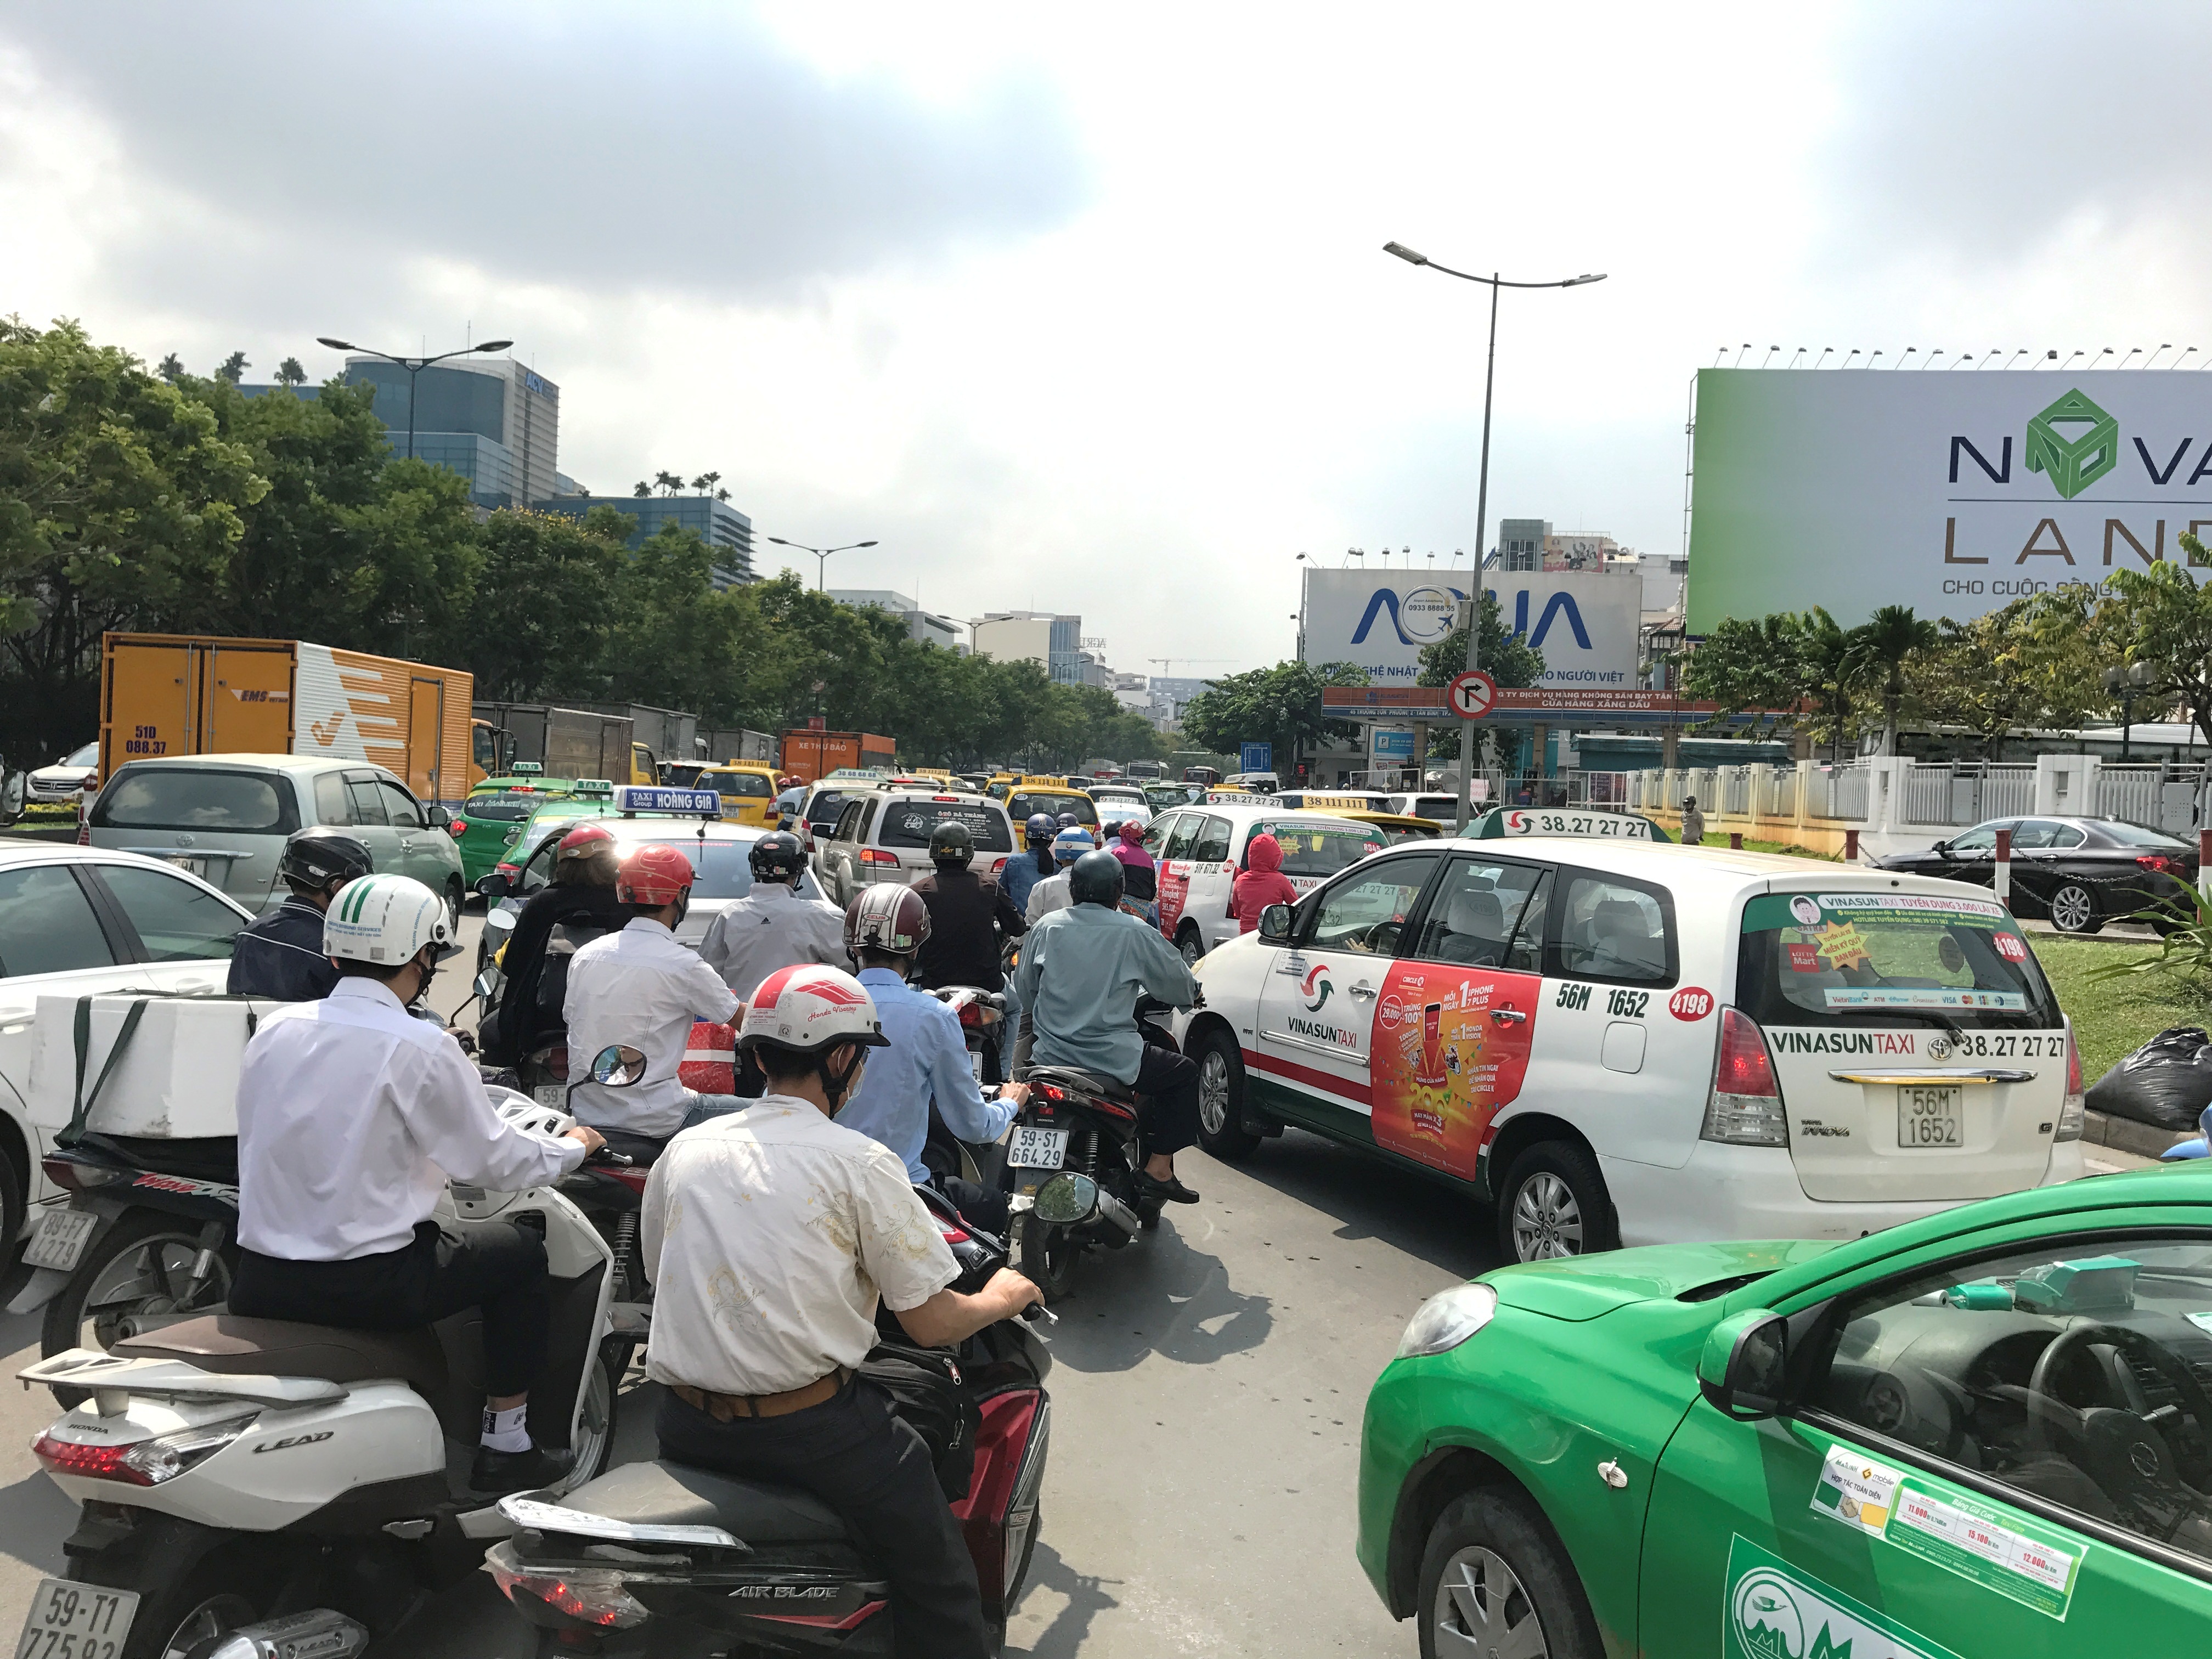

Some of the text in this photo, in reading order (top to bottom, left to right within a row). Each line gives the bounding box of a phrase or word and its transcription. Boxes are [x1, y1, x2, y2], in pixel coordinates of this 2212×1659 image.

[1943, 578, 2047, 597] CHO CUỘC
[1350, 588, 1593, 650] AUA
[1387, 665, 1624, 685] NHẬT NGƯỜI VIỆT
[241, 690, 268, 702] EMS
[135, 725, 156, 740] 51D
[126, 740, 166, 754] 088.37
[798, 742, 809, 750] XE
[583, 781, 606, 789] TAXI
[657, 791, 693, 809] HOÀNG
[695, 794, 712, 810] GIA
[1225, 794, 1281, 807] 38.27 27 27
[1307, 796, 1363, 809] 38 111 111
[1541, 815, 1646, 838] 38.27 27 27
[1194, 863, 1205, 874] 51F
[1299, 879, 1317, 888] TAXI
[1369, 885, 1396, 896] 27 27
[1161, 888, 1180, 900] Bangkok
[1899, 896, 1930, 908] TUYỂN
[1931, 899, 1956, 910] DỤNG
[1957, 902, 1978, 912] 3.000
[1978, 904, 1990, 913] LÁI
[1991, 907, 2001, 916] XE
[1994, 936, 2024, 957] 4198
[1793, 957, 1816, 966] Mart
[1834, 953, 1849, 963] BAN
[1402, 976, 1418, 984] CIRCLE
[1444, 990, 1489, 1007] MỖI 7 PLUS
[1459, 980, 1494, 1008] 1 IPHONE
[1556, 983, 1650, 1019] 56M 1652
[1443, 1000, 1459, 1012] NGÀY
[1671, 993, 1708, 1015] 4198
[808, 1009, 832, 1022] Honda
[1404, 1011, 1422, 1024] 100%
[1460, 1023, 1466, 1040] 1
[1466, 1032, 1481, 1040] VISION
[1961, 1035, 2016, 1057] 38.27
[2024, 1036, 2041, 1058] 27
[2047, 1037, 2064, 1058] 27
[1409, 1082, 1448, 1118] 200
[1912, 1090, 1950, 1116] 56M
[1020, 1130, 1059, 1149] 59-S1
[1908, 1118, 1956, 1144] 1652
[1011, 1147, 1061, 1167] 664.29
[132, 1172, 203, 1194] Wave
[44, 1213, 89, 1240] 89-F7
[33, 1237, 77, 1265] 4279
[67, 1424, 109, 1435] HONDA
[252, 1431, 335, 1454] LEAD
[1831, 1474, 1882, 1501] HỢP TÁC TOÀN DIỆN
[1872, 1474, 1895, 1486] mobile
[1951, 1498, 1970, 1511] Bảng
[1969, 1505, 1981, 1515] Giá
[2000, 1518, 2011, 1528] Taxi
[727, 1585, 840, 1599] AIR BLADE
[44, 1587, 120, 1635] 59-T1
